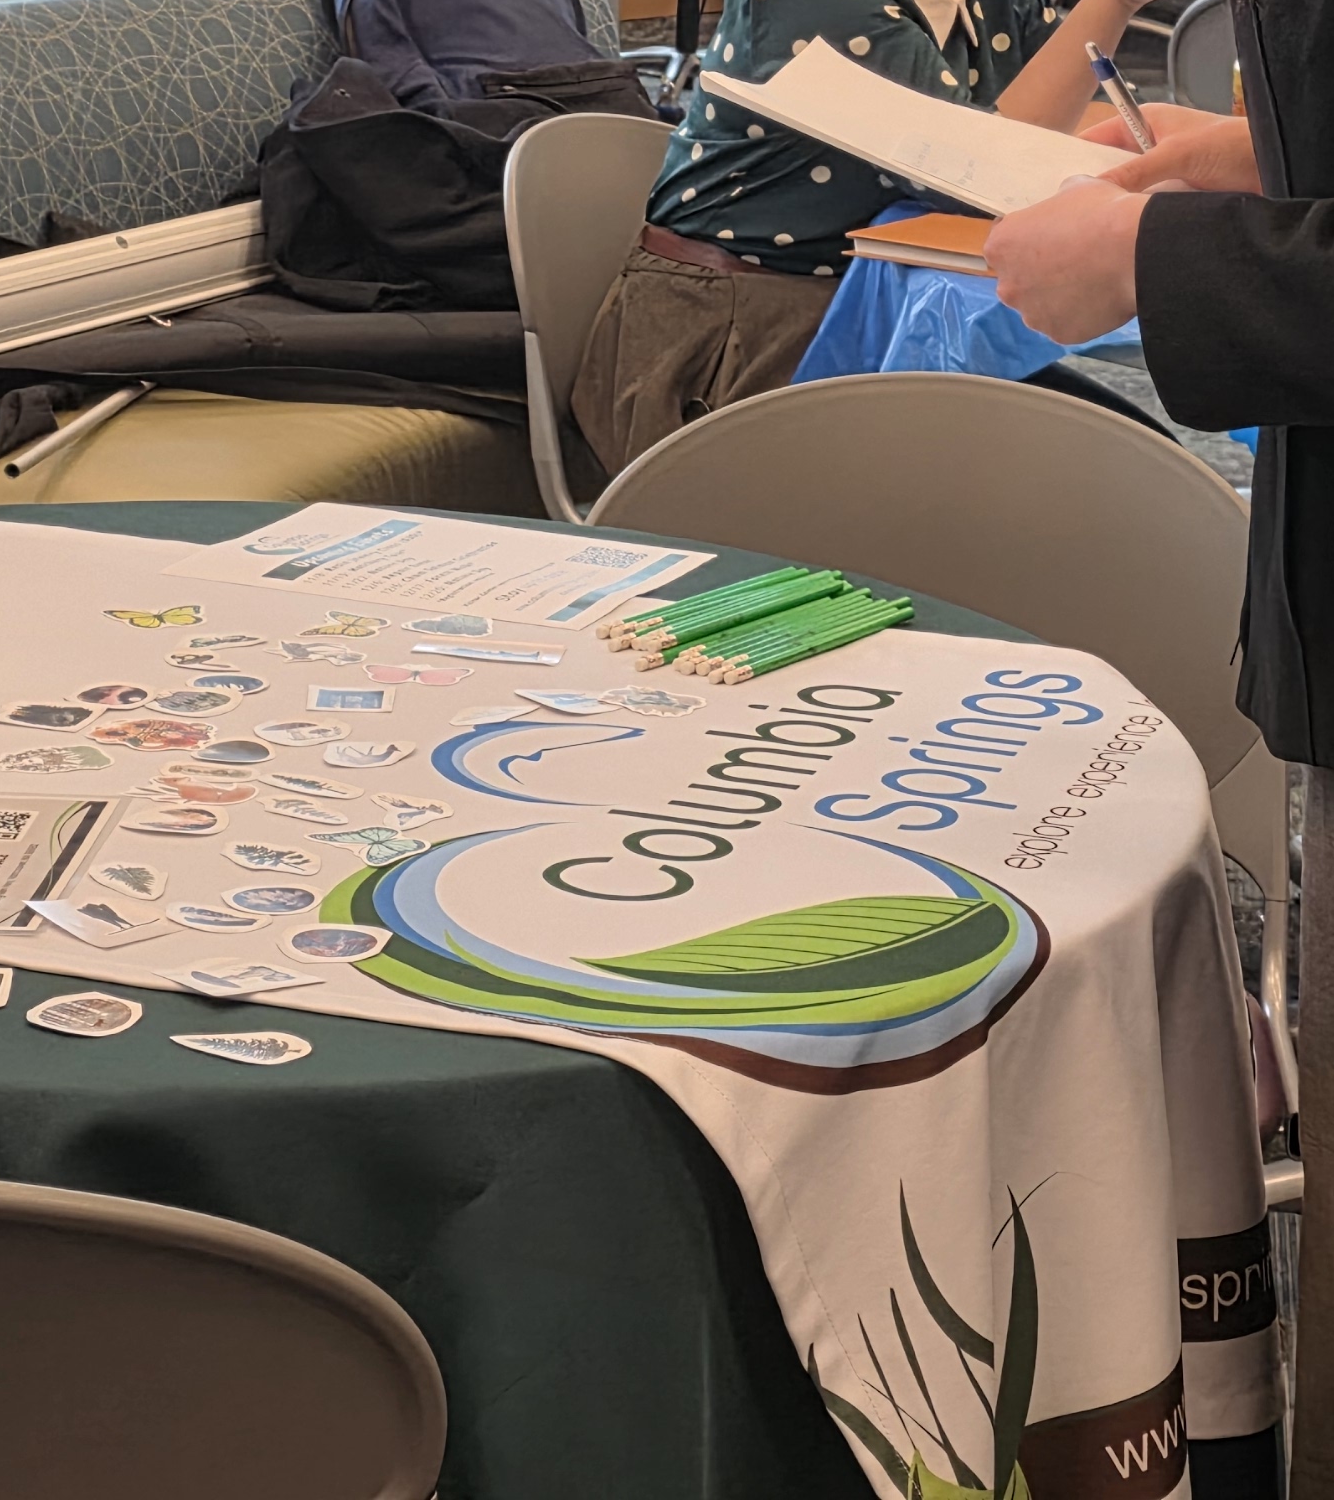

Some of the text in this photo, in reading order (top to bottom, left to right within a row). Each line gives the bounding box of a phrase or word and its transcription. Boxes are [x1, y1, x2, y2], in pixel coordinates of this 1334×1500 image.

[542, 684, 904, 901] Columbia
[815, 669, 1104, 831] Springs
[1004, 714, 1163, 870] explore experience
